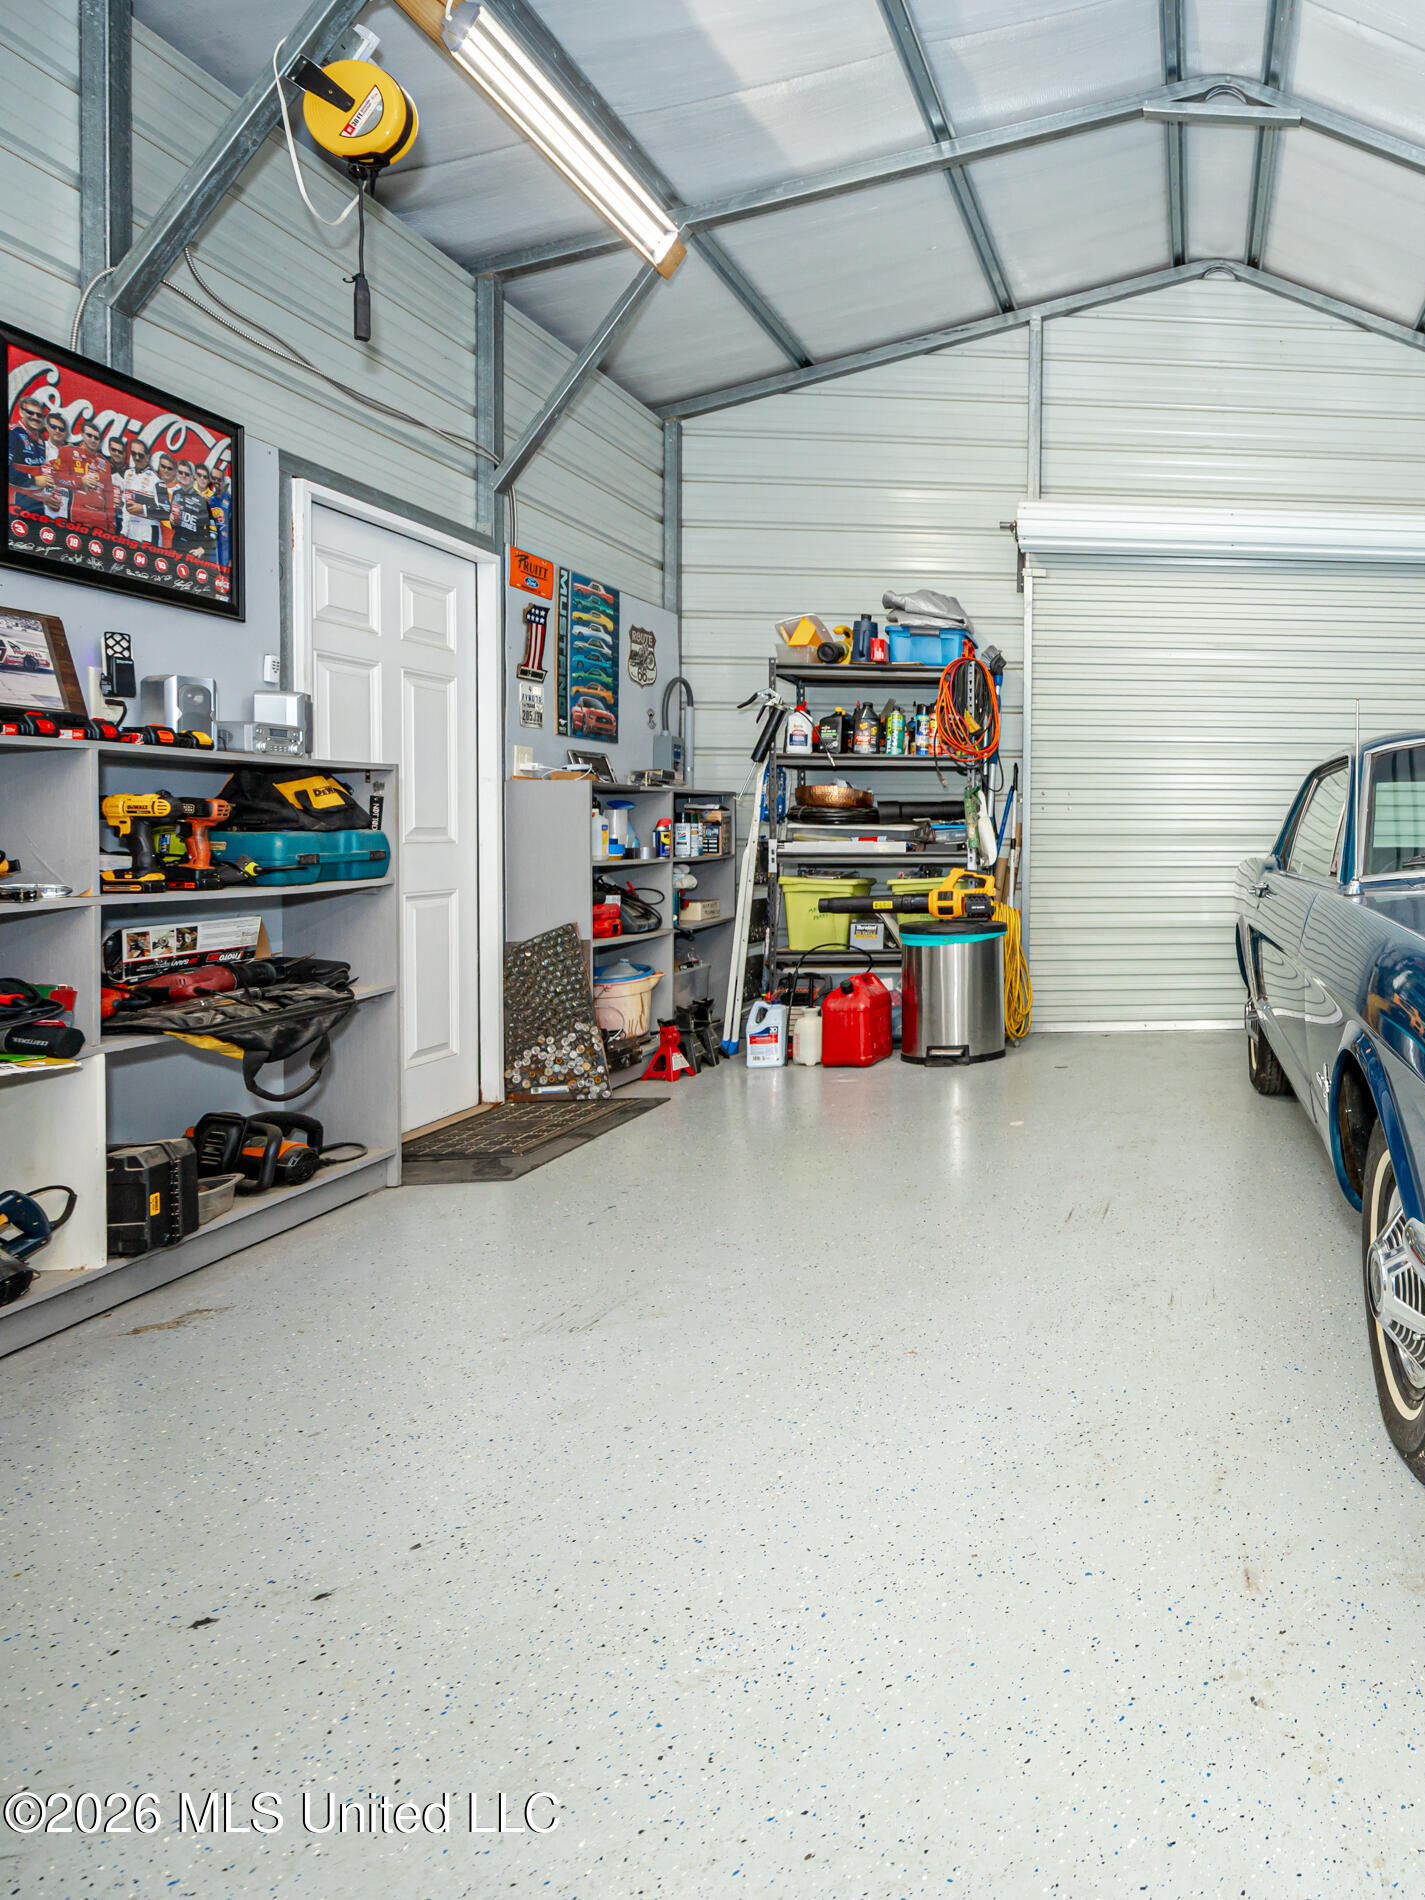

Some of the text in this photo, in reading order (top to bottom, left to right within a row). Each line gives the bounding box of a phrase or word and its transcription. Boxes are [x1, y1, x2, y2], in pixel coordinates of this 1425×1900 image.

[8, 505, 89, 534] Coca-Cola
[92, 527, 139, 550] Racing
[141, 541, 183, 561] Family
[185, 553, 231, 574] Reunion
[514, 554, 549, 578] PRUITT
[558, 569, 569, 717] MUSTANG
[631, 630, 654, 648] ROUTE
